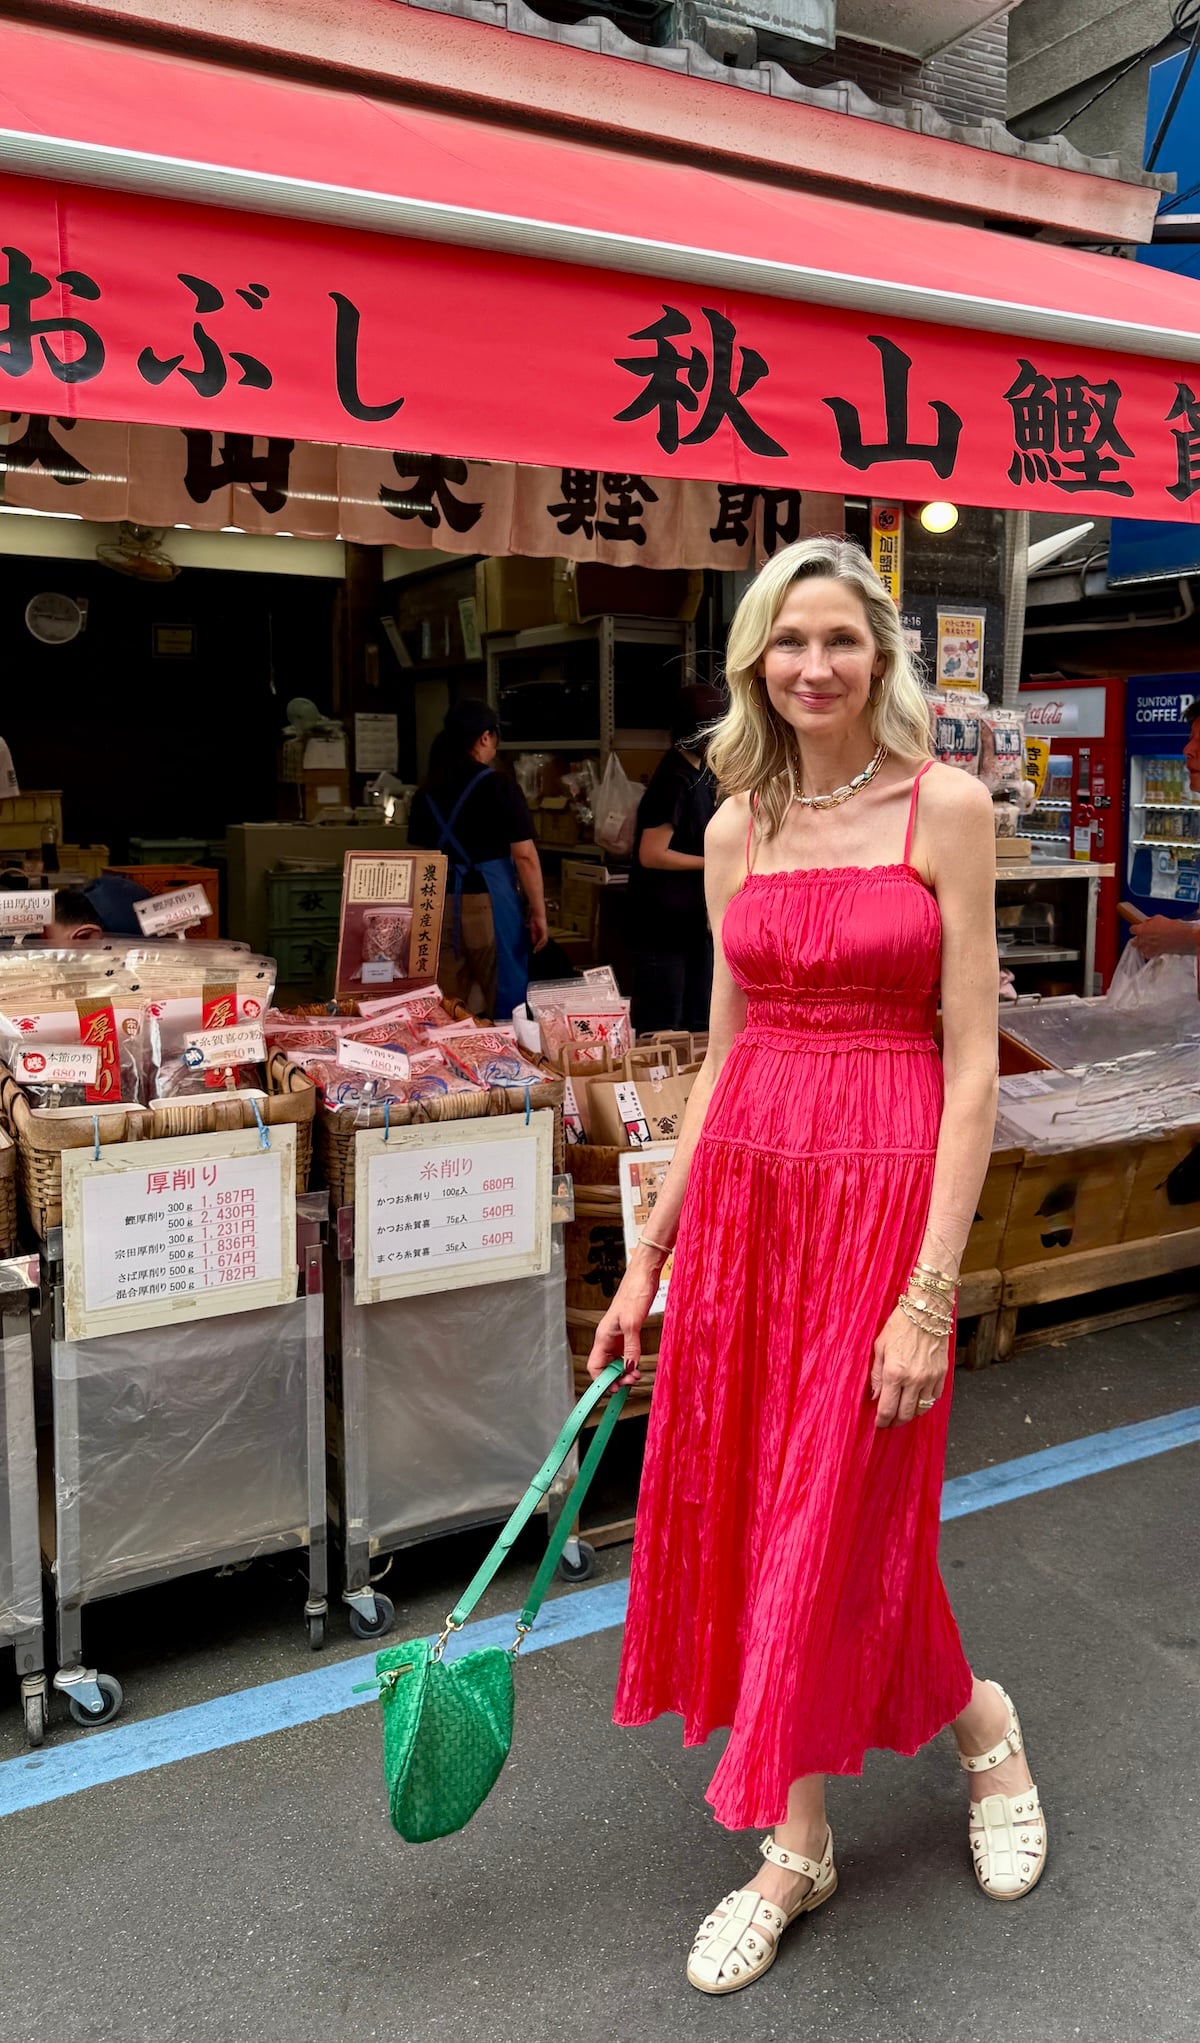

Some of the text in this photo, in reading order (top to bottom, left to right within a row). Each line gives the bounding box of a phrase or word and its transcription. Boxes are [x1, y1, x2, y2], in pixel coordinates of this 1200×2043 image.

[1136, 696, 1178, 708] SUNTORY
[1135, 709, 1178, 722] COFFEE
[416, 863, 438, 972] 農林水産大臣賞
[48, 1051, 93, 1064] 本節の粉
[52, 1068, 87, 1078] 680円
[420, 1158, 473, 1181] 糸削り
[146, 1165, 218, 1195] 厚削り
[377, 1192, 431, 1207] かつお糸削り
[482, 1177, 514, 1191] 680円
[124, 1212, 165, 1226] 鰹厚削り
[377, 1220, 431, 1235] かつお糸賀喜
[482, 1204, 513, 1219] 540円
[114, 1242, 166, 1260] 宗田厚削り
[377, 1247, 430, 1263] まぐろ糸賀喜
[481, 1231, 513, 1246] 540円
[118, 1267, 167, 1283] さば厚削り
[116, 1283, 167, 1300] 混合厚削り
